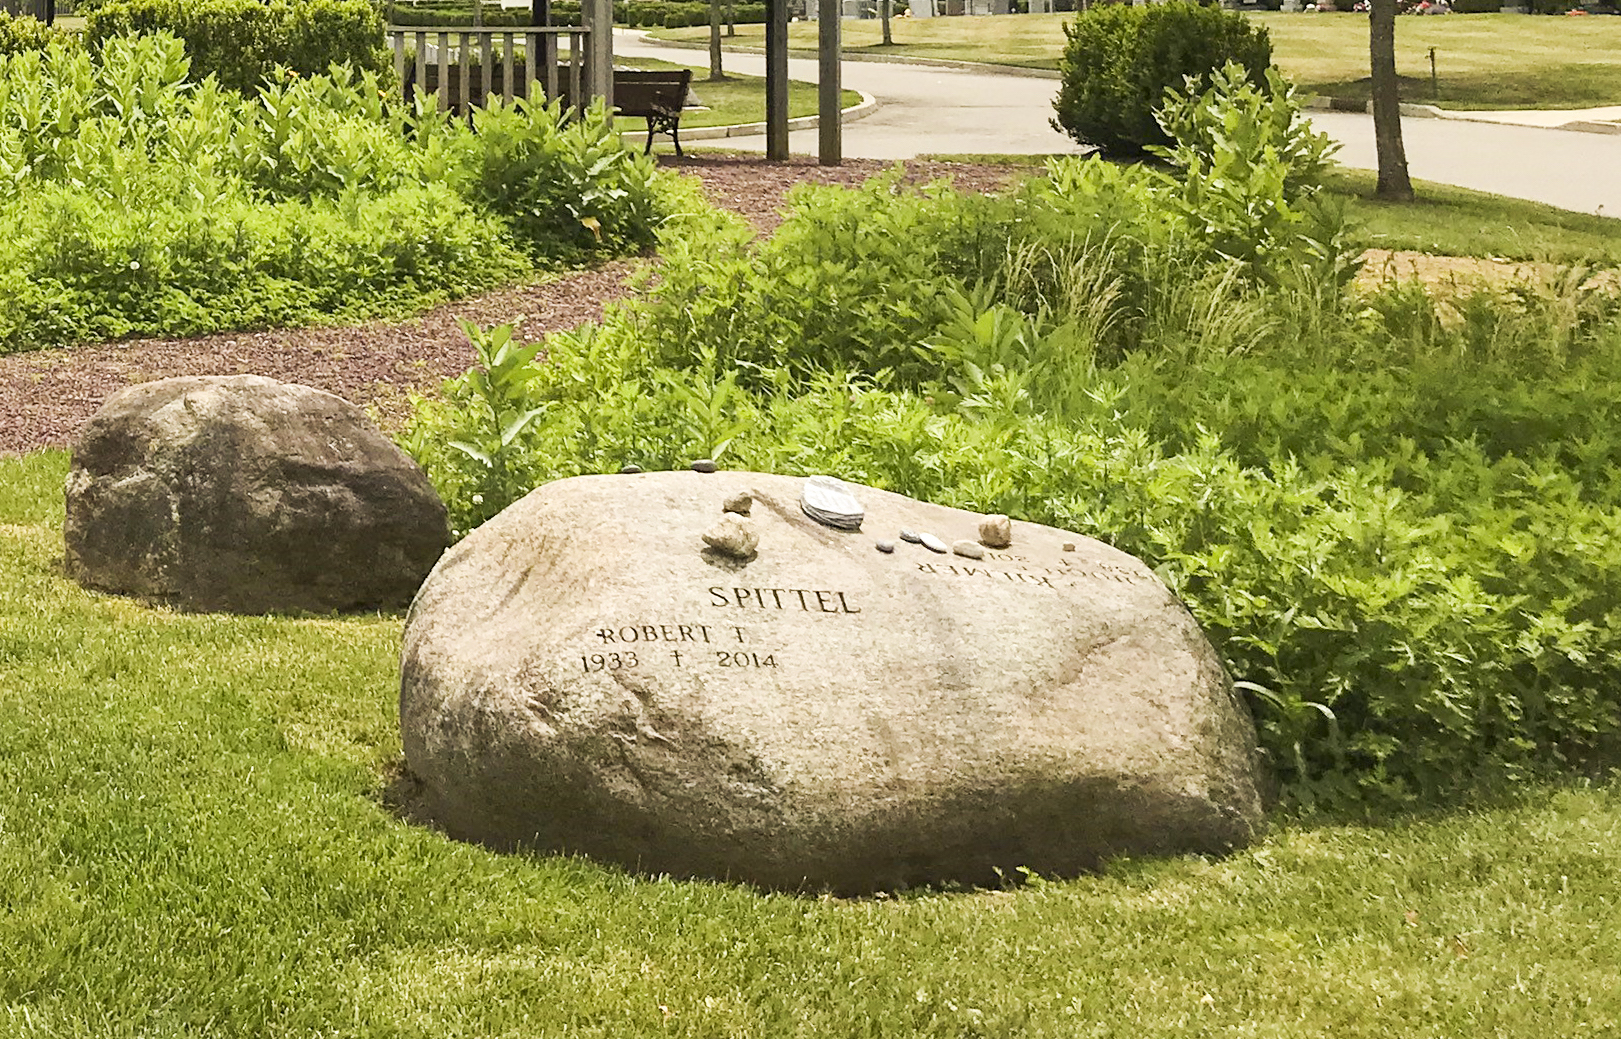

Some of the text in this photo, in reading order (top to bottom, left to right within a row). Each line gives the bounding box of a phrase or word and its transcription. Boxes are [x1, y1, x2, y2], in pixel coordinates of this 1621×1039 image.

[708, 586, 862, 615] SPITTEL
[599, 624, 746, 644] ROBERT T
[581, 651, 779, 673] 1933 2014
